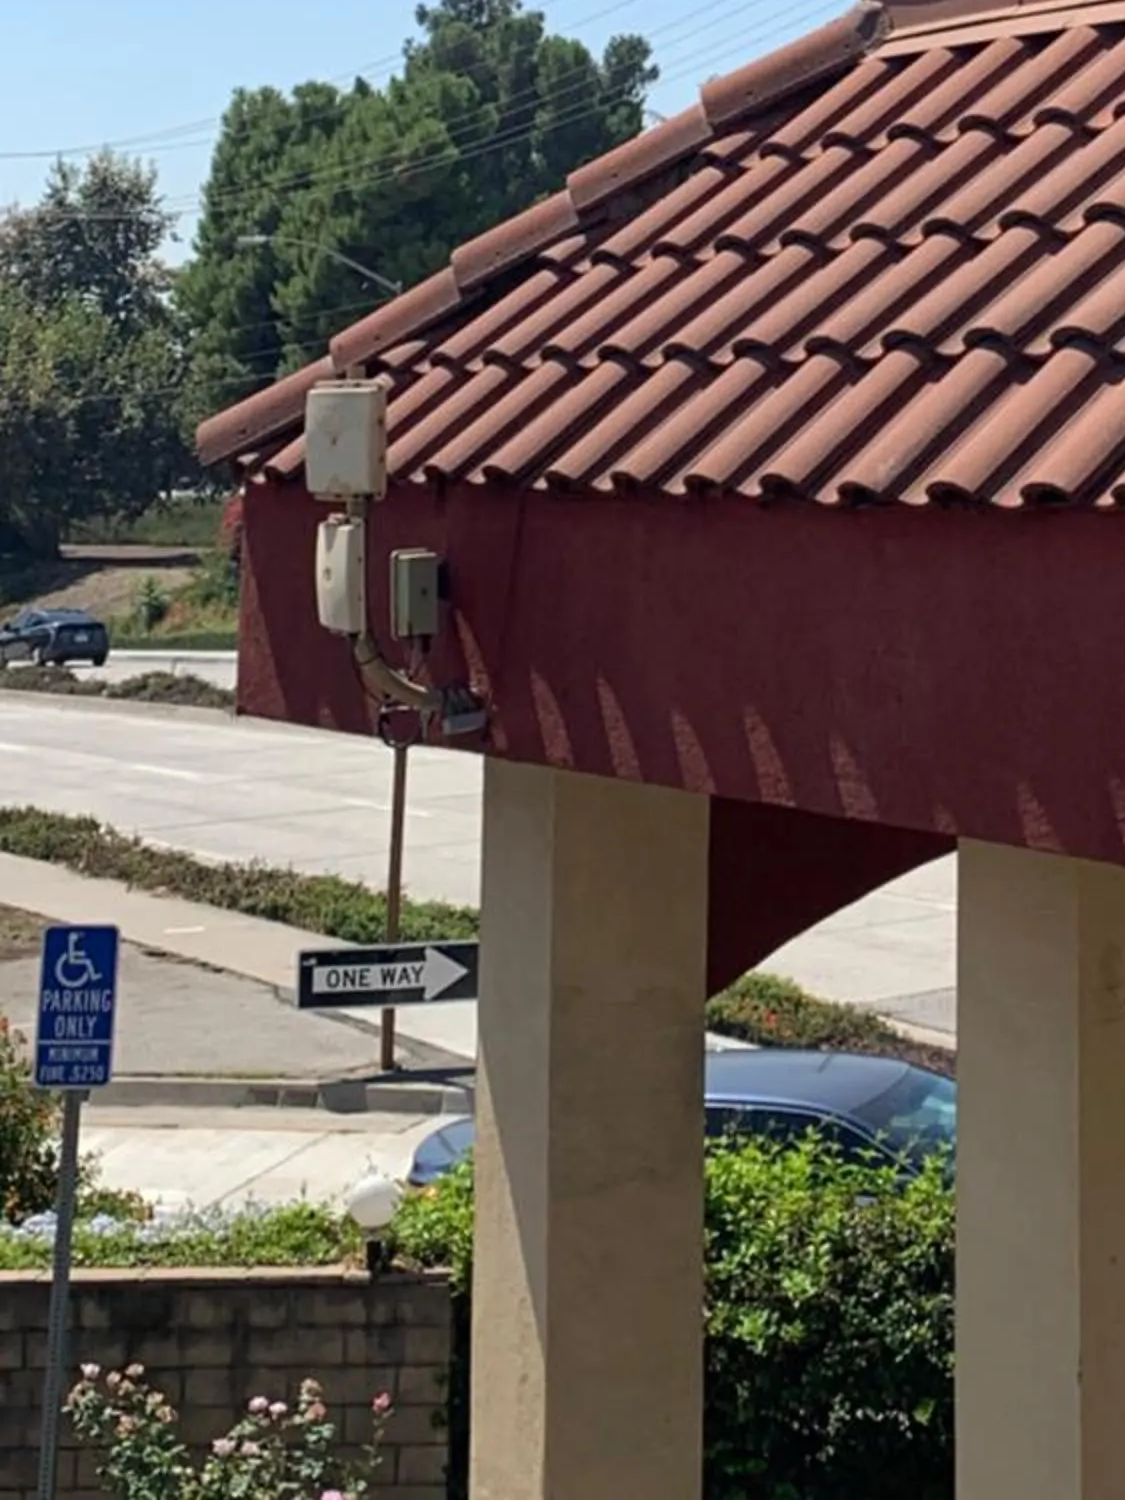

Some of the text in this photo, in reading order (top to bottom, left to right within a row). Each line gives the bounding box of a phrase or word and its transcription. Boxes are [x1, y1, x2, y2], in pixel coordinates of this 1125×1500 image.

[326, 965, 424, 988] ONE WAY
[42, 989, 111, 1012] PARKING
[54, 1015, 96, 1038] ONLY
[48, 1047, 98, 1061] MINIMUM
[40, 1065, 65, 1081] FINE
